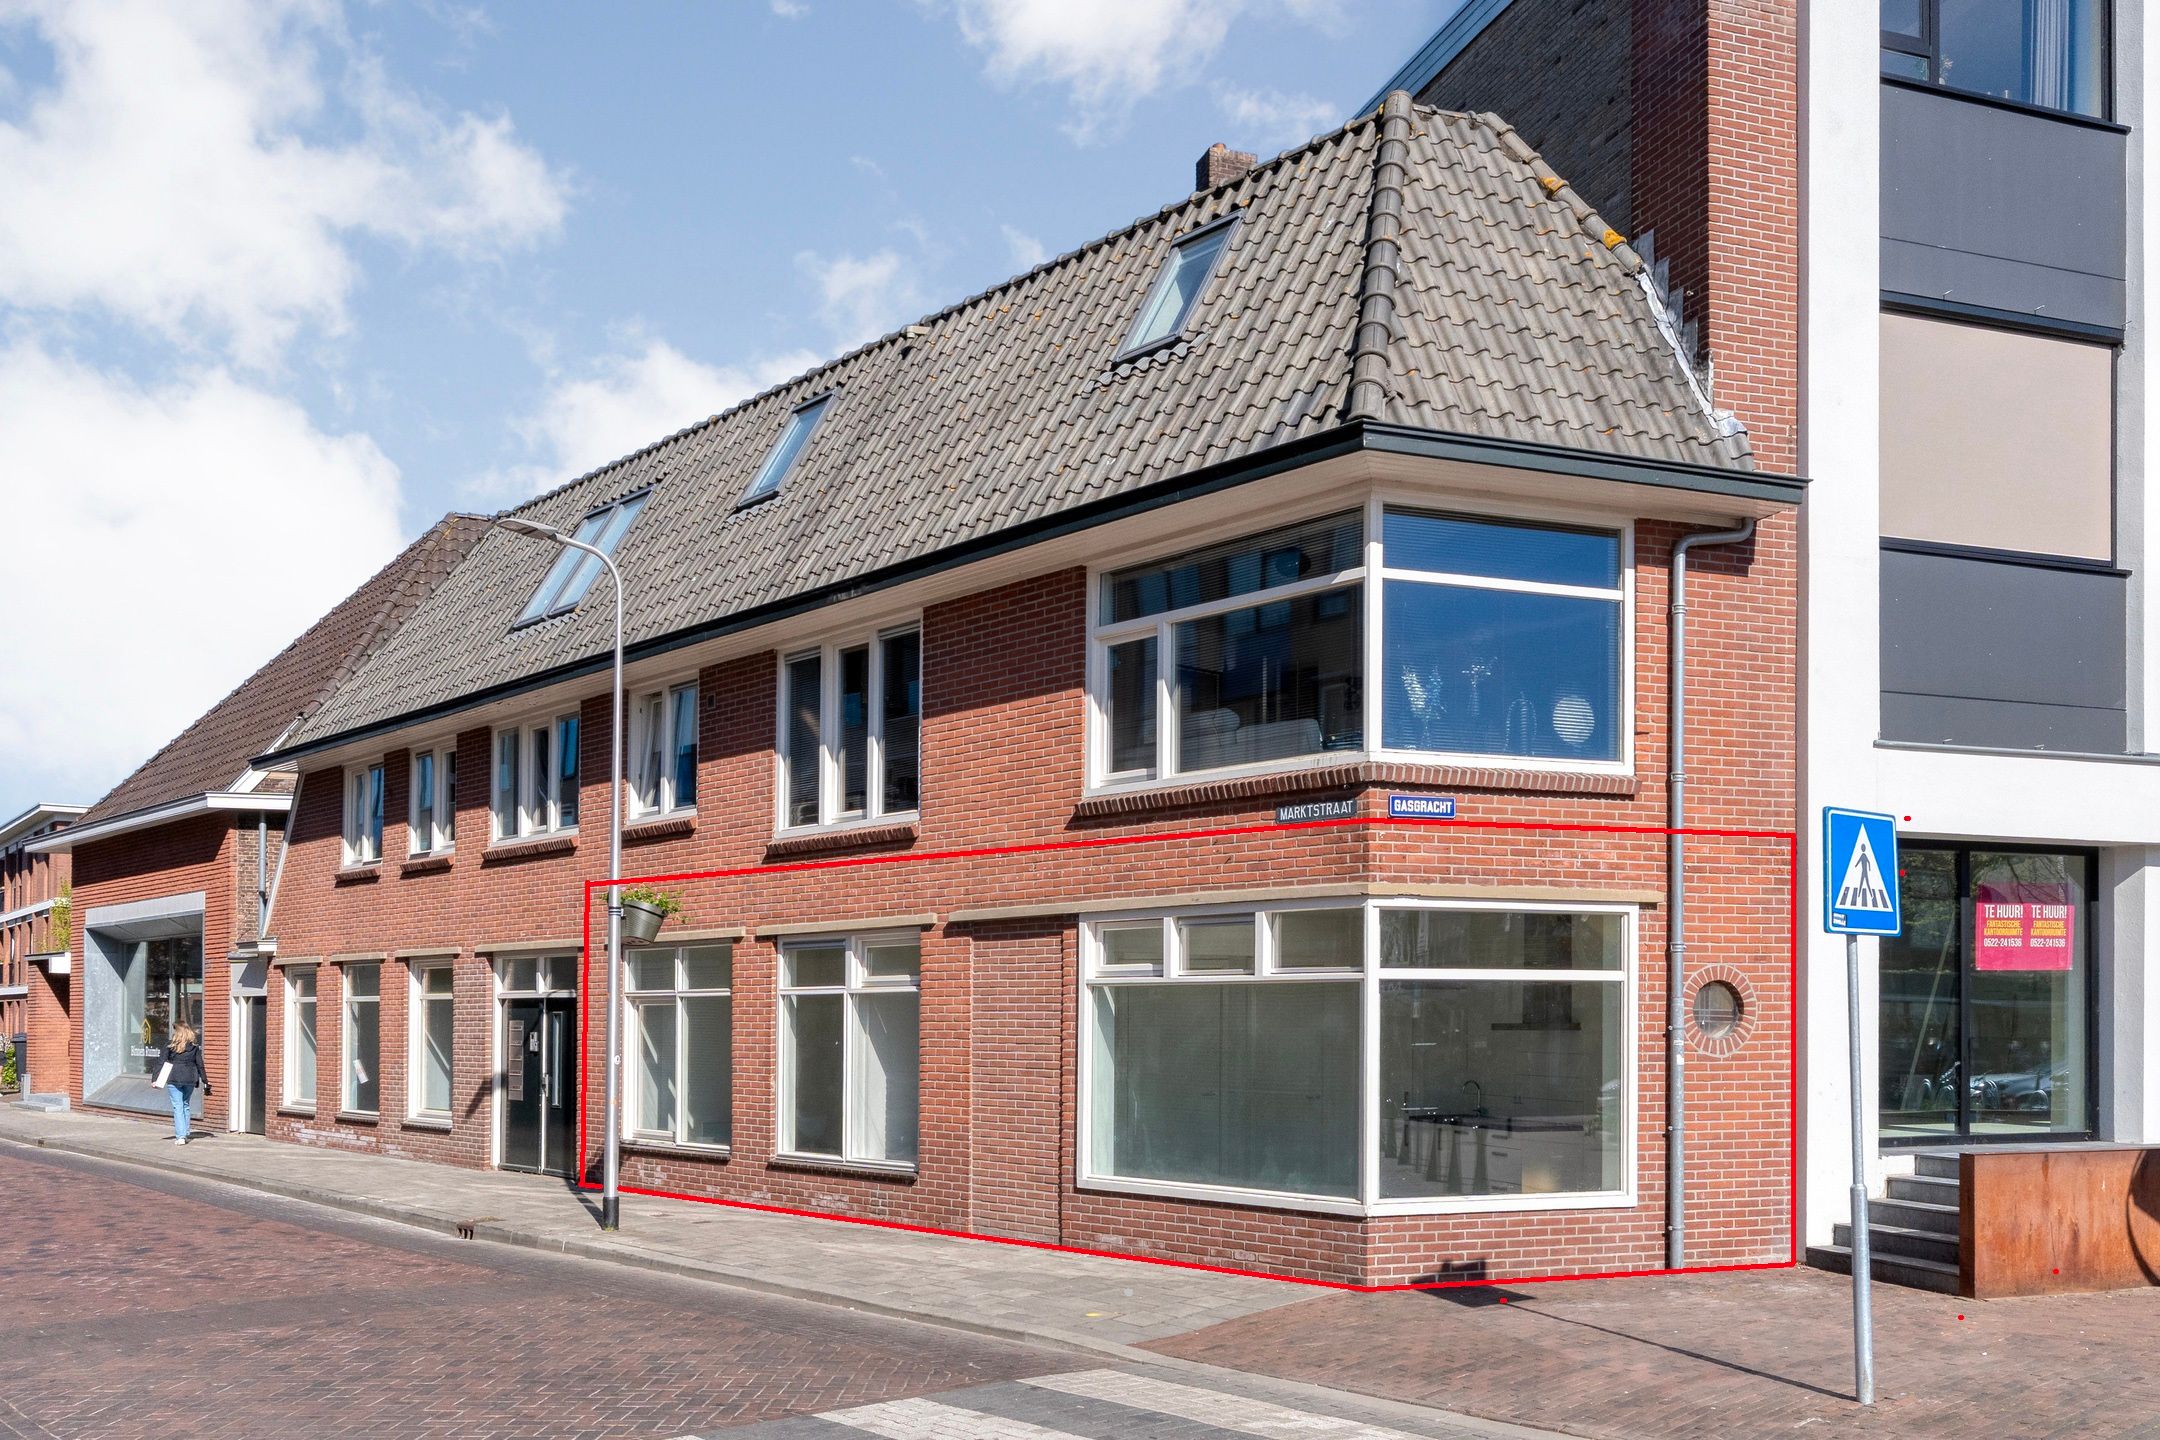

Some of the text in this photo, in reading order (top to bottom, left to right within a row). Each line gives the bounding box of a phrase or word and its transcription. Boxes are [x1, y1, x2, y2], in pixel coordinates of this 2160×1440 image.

[1279, 800, 1354, 821] MARKTSTRAAT
[1394, 799, 1452, 814] GASGRACHT
[1984, 904, 2023, 919] TE HUUR!
[2031, 905, 2067, 919] TE HUUR!
[1983, 938, 2022, 947] 0522-241536
[2030, 938, 2066, 948] 0522-241536
